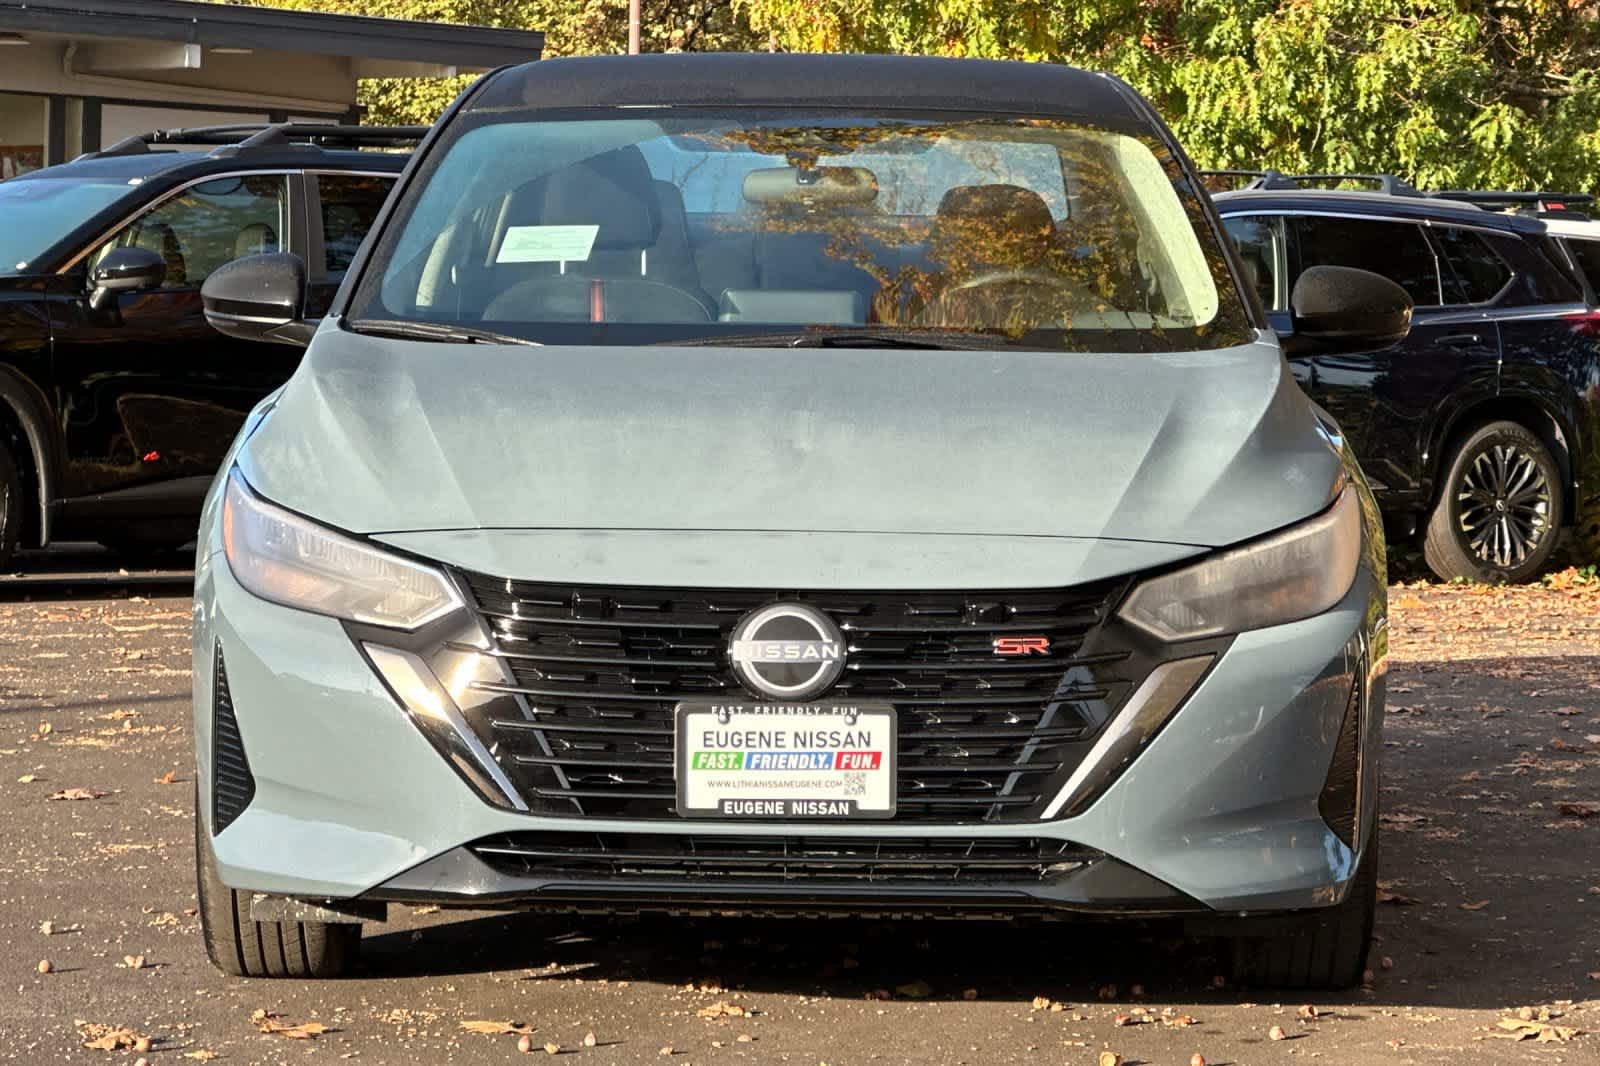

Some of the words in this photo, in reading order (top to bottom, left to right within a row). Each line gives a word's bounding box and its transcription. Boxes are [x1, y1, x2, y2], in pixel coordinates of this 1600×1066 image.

[992, 637, 1050, 655] SR
[754, 706, 828, 716] FRIENDLY.
[703, 731, 786, 748] EUGENE
[793, 731, 871, 748] NISSAN
[697, 753, 739, 769] FAST.
[750, 753, 829, 769] FRIENDLY.
[840, 753, 877, 769] FUN.
[724, 801, 785, 815] EUGENE
[792, 802, 849, 815] NISSAN
